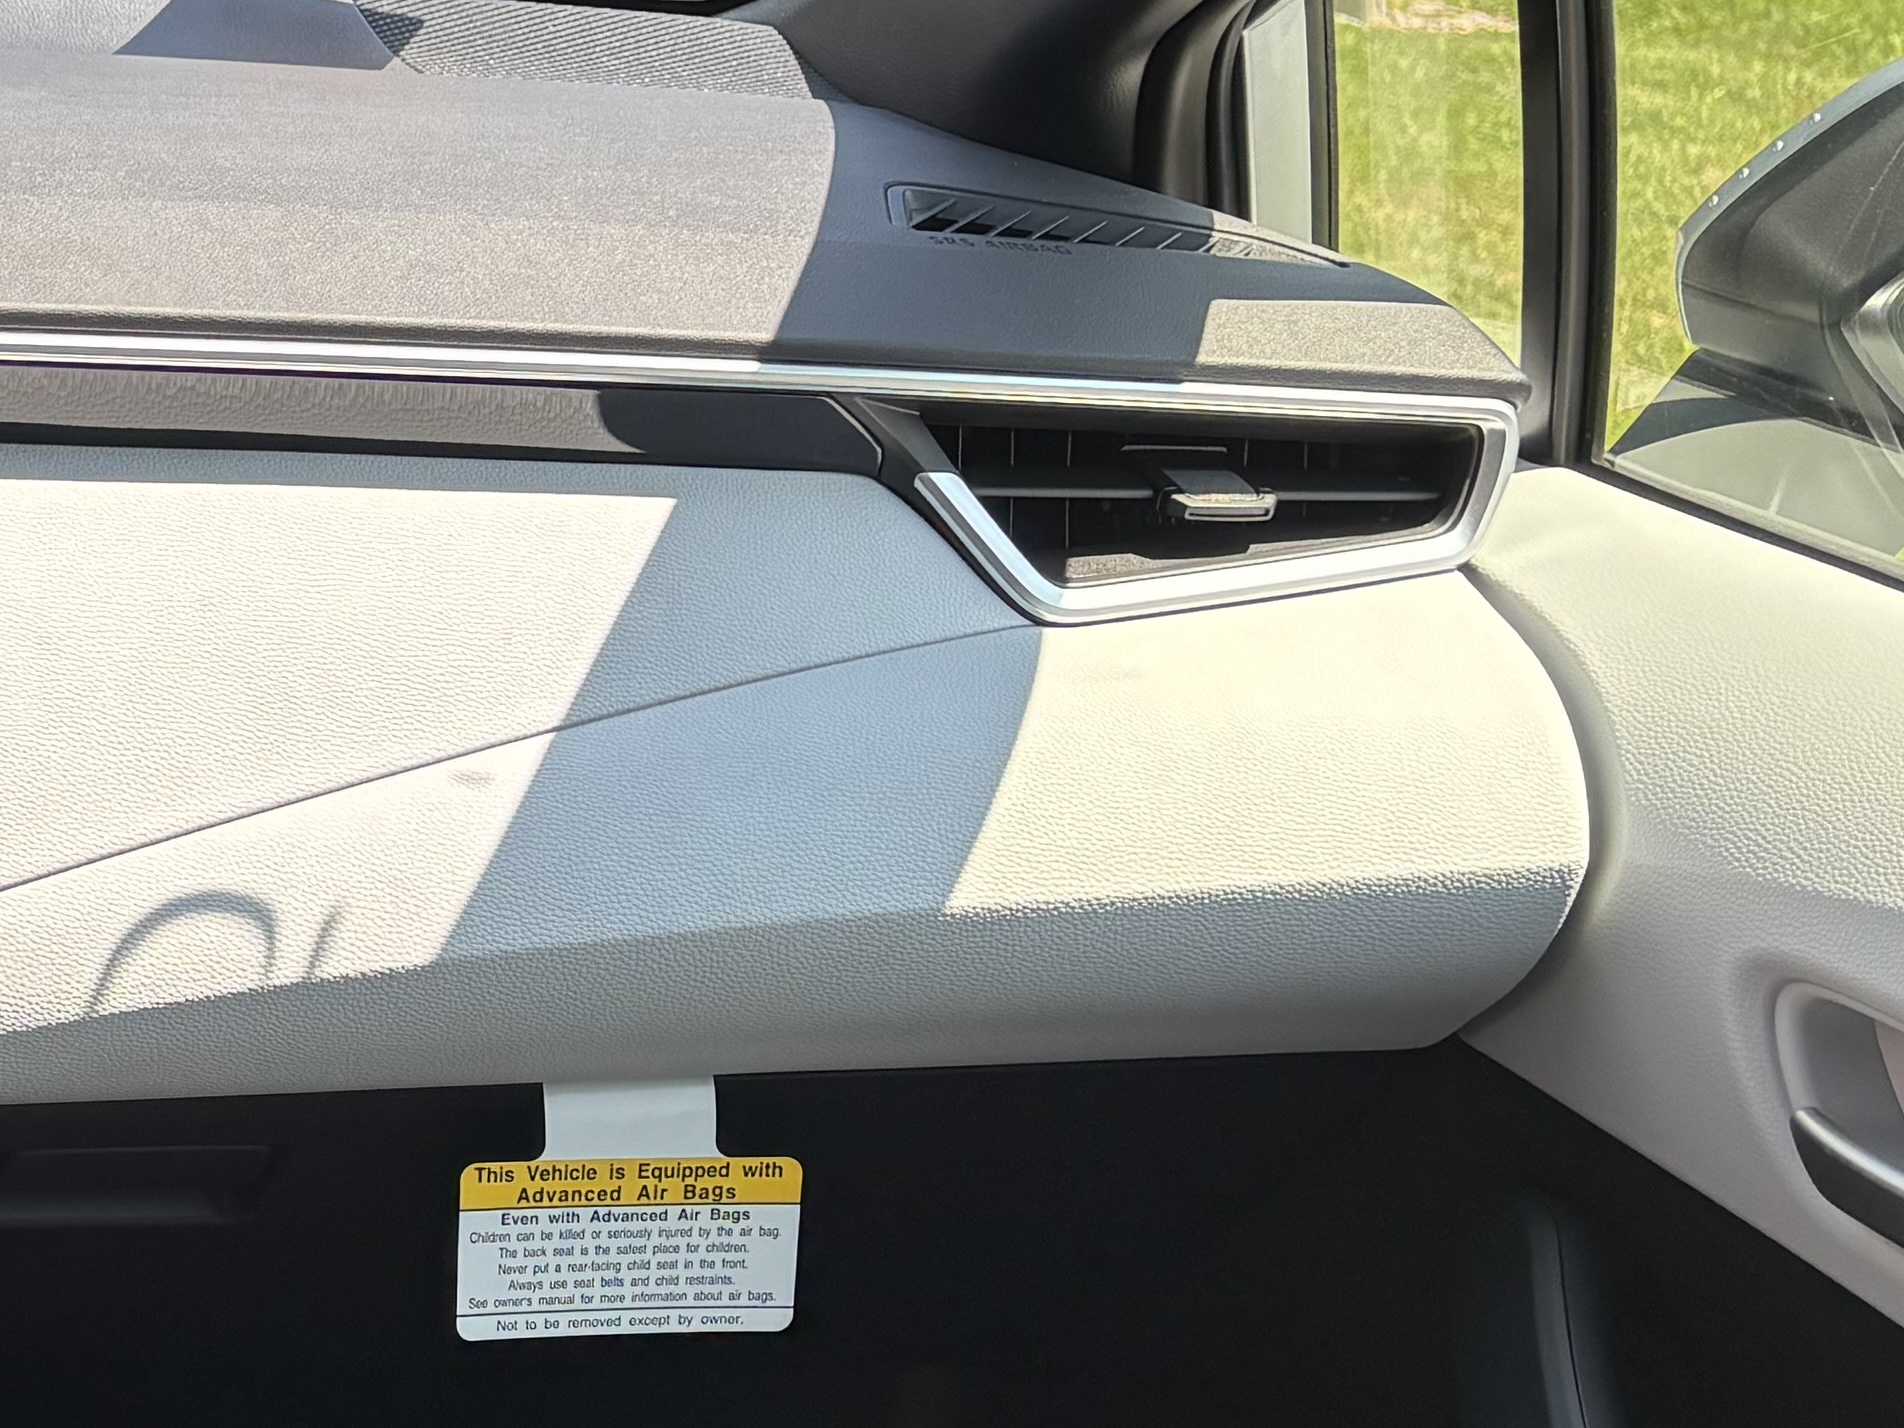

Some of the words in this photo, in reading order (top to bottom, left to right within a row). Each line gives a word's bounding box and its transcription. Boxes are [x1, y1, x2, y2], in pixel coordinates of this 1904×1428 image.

[473, 1166, 515, 1183] This
[527, 1164, 598, 1181] Vehicle
[609, 1163, 626, 1180] is
[637, 1162, 731, 1182] Equipped
[742, 1161, 783, 1178] with
[517, 1185, 622, 1204] Advanced
[637, 1184, 668, 1201] Air
[683, 1184, 736, 1202] Bags
[500, 1213, 539, 1226] Even
[548, 1211, 580, 1223] with
[589, 1209, 669, 1223] Advanced
[677, 1208, 701, 1221] Air
[710, 1208, 751, 1223] Bags
[469, 1231, 511, 1244] Children
[516, 1232, 535, 1243] can
[540, 1230, 554, 1241] be
[559, 1228, 586, 1240] killed
[591, 1230, 602, 1240] or
[607, 1228, 652, 1241] seriously
[658, 1226, 693, 1240] injured
[698, 1226, 712, 1240] by
[717, 1226, 734, 1237] the
[739, 1225, 753, 1236] air
[759, 1225, 782, 1240] bag.
[499, 1247, 518, 1259] The
[523, 1246, 547, 1258] back
[552, 1245, 575, 1257] seat
[580, 1245, 589, 1256] is
[594, 1244, 611, 1256] the
[616, 1243, 647, 1256] safest
[652, 1243, 681, 1256] place
[686, 1243, 700, 1254] for
[705, 1242, 750, 1254] children.
[498, 1263, 528, 1275] Never
[532, 1262, 549, 1276] put
[554, 1263, 562, 1274] a
[567, 1260, 622, 1274] rear-facing
[626, 1259, 651, 1271] child
[656, 1259, 679, 1271] seat
[684, 1258, 694, 1269] in
[699, 1258, 716, 1269] the
[722, 1257, 748, 1269] front.
[508, 1279, 543, 1293] Always
[549, 1279, 568, 1290] use
[573, 1277, 595, 1289] seat
[600, 1276, 625, 1288] belts
[630, 1275, 650, 1287] and
[655, 1274, 680, 1286] child
[684, 1274, 736, 1286] restraints.
[496, 1319, 518, 1331] Not
[525, 1318, 537, 1330] to
[544, 1317, 560, 1329] be
[567, 1315, 622, 1328] removed
[628, 1314, 671, 1330] except
[677, 1313, 694, 1327] by
[700, 1313, 745, 1325] owner.
